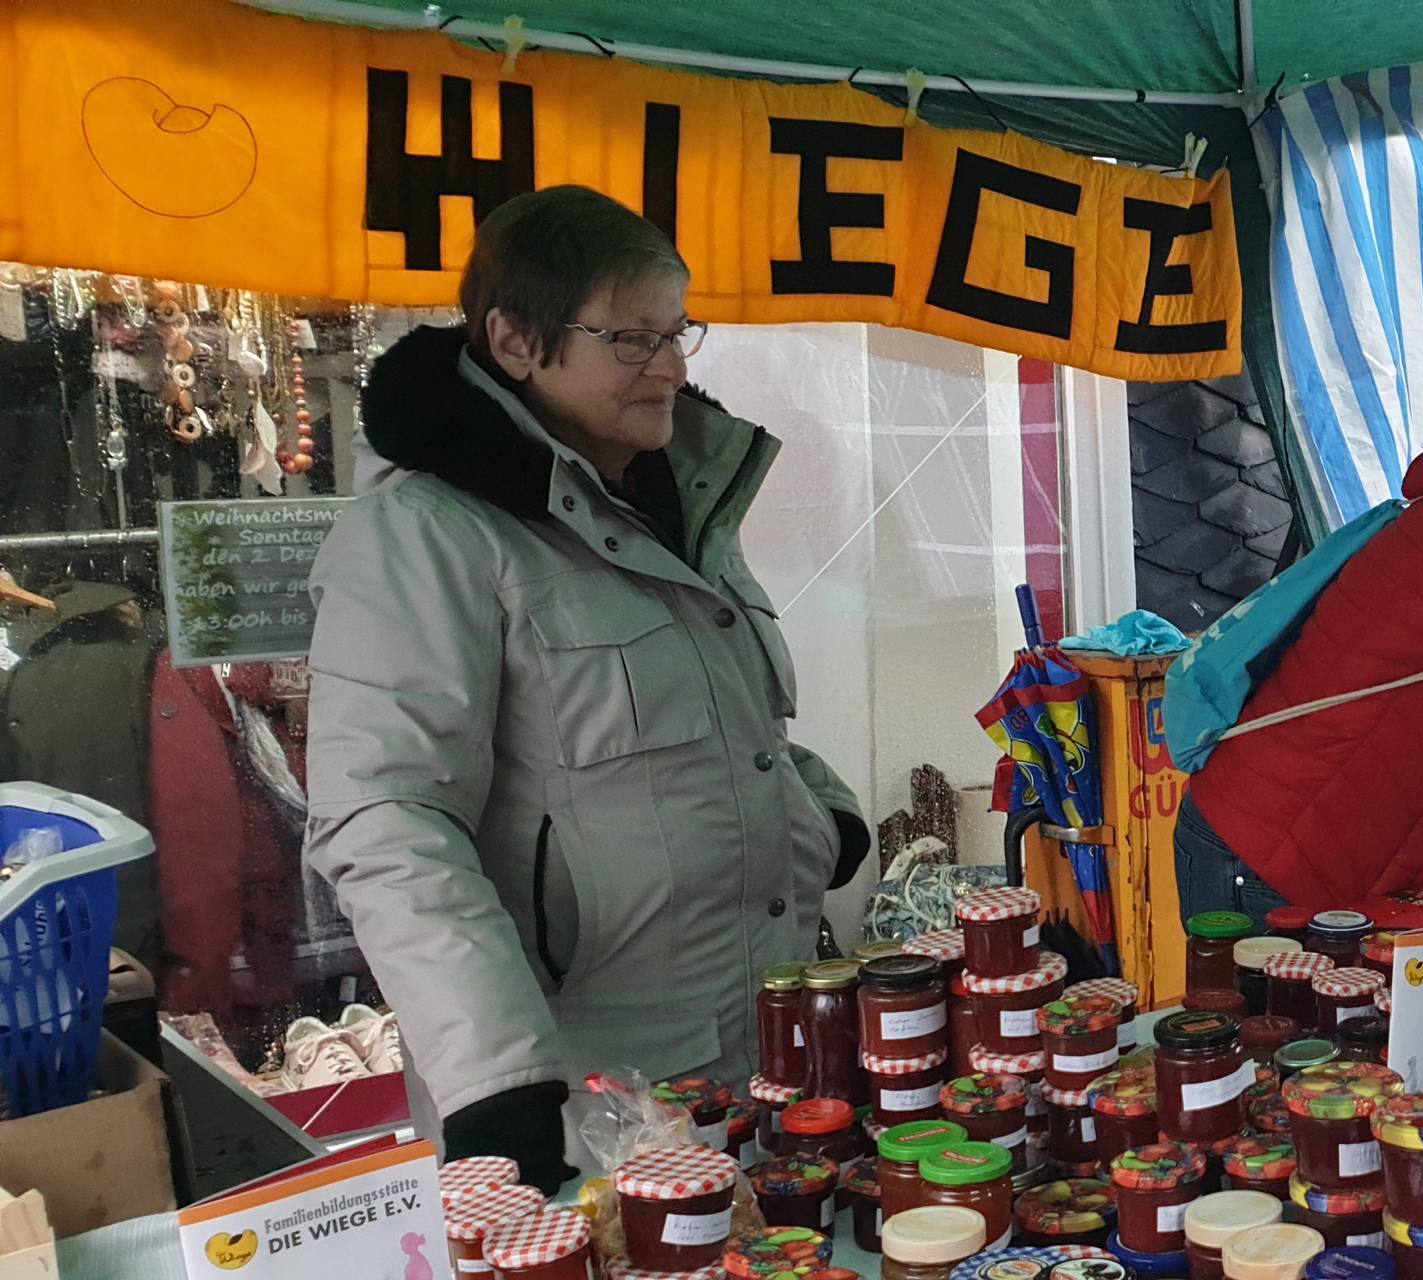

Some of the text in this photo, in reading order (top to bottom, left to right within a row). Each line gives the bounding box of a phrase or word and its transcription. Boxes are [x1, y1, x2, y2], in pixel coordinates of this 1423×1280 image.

[365, 67, 1227, 354] WIEGE
[203, 550, 241, 566] den
[243, 577, 280, 594] wir
[280, 608, 308, 625] bis
[264, 1177, 419, 1234] Familienbildungsstätte
[268, 1194, 422, 1255] DIE WIEGE E.V.
